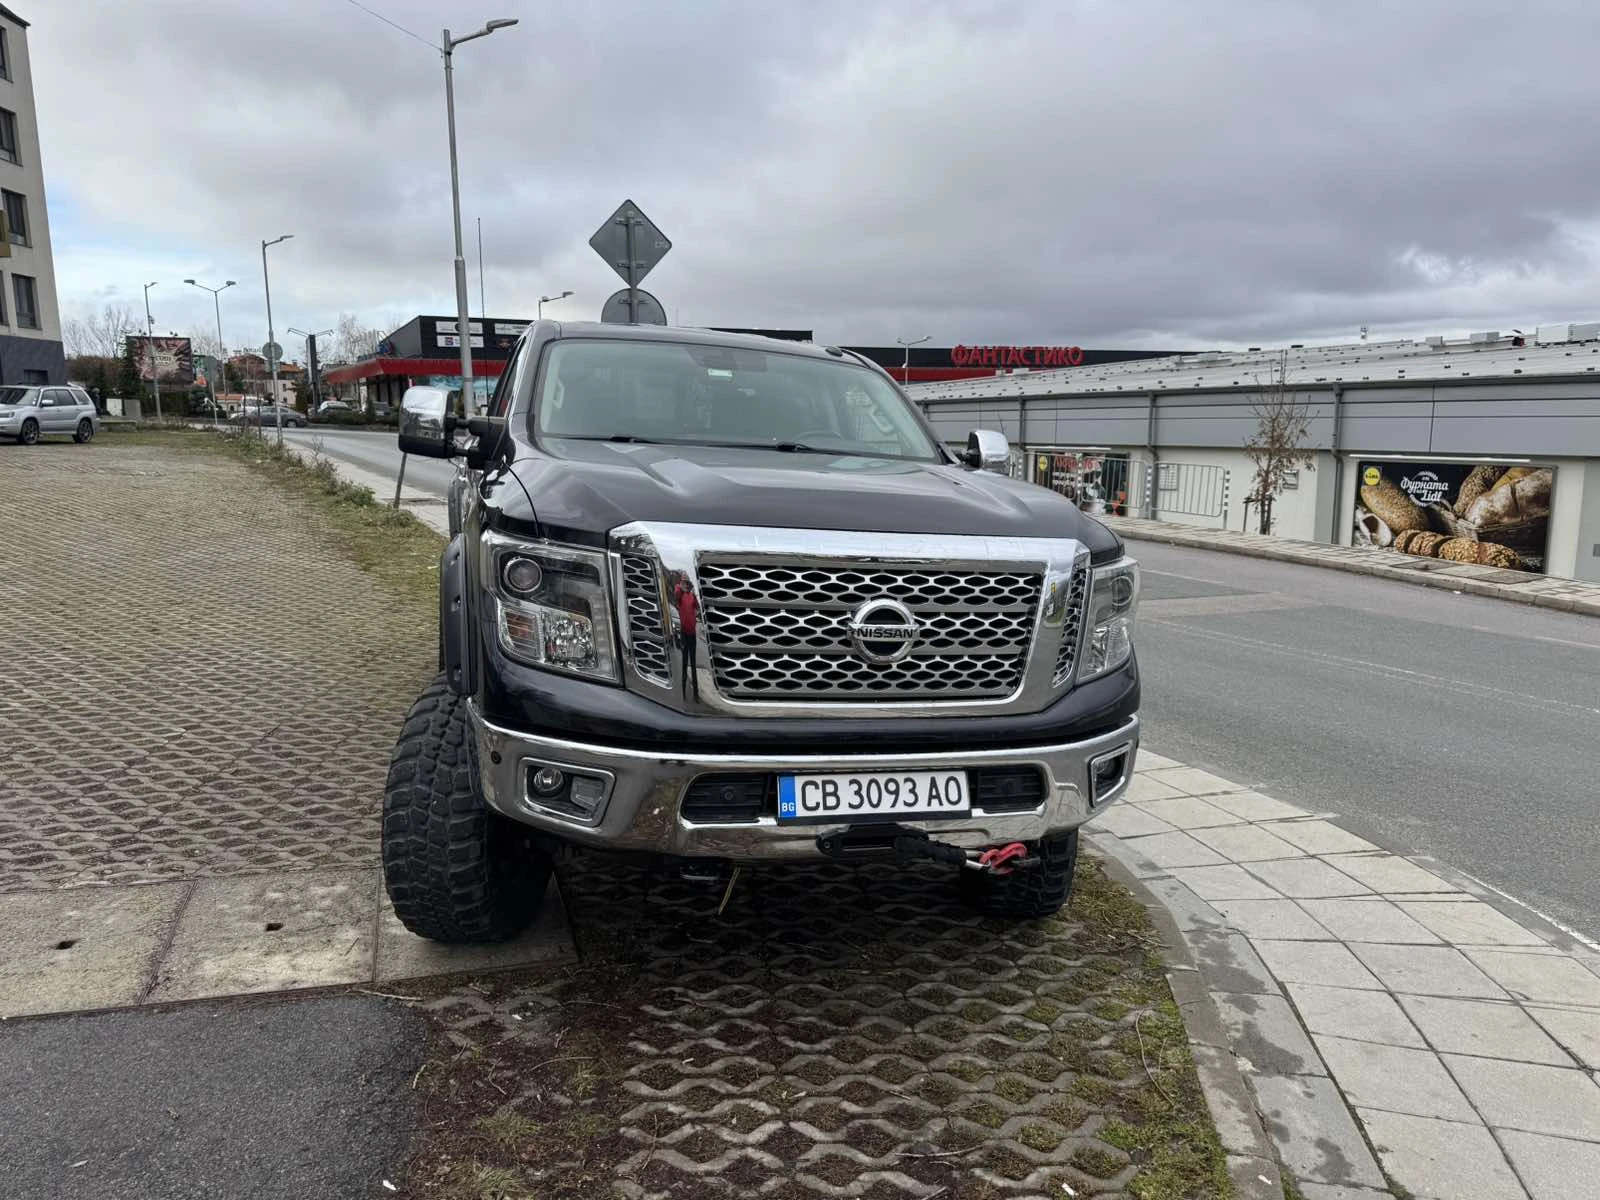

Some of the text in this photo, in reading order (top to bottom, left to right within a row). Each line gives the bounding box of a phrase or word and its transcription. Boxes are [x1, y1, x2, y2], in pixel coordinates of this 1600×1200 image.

[951, 344, 1084, 366] ФАНТАСТИКО
[1400, 476, 1449, 494] Фурната
[1420, 489, 1442, 502] Lidl
[856, 628, 913, 639] NISSAN
[801, 775, 962, 812] CB 3093 AO
[781, 802, 795, 813] BG
